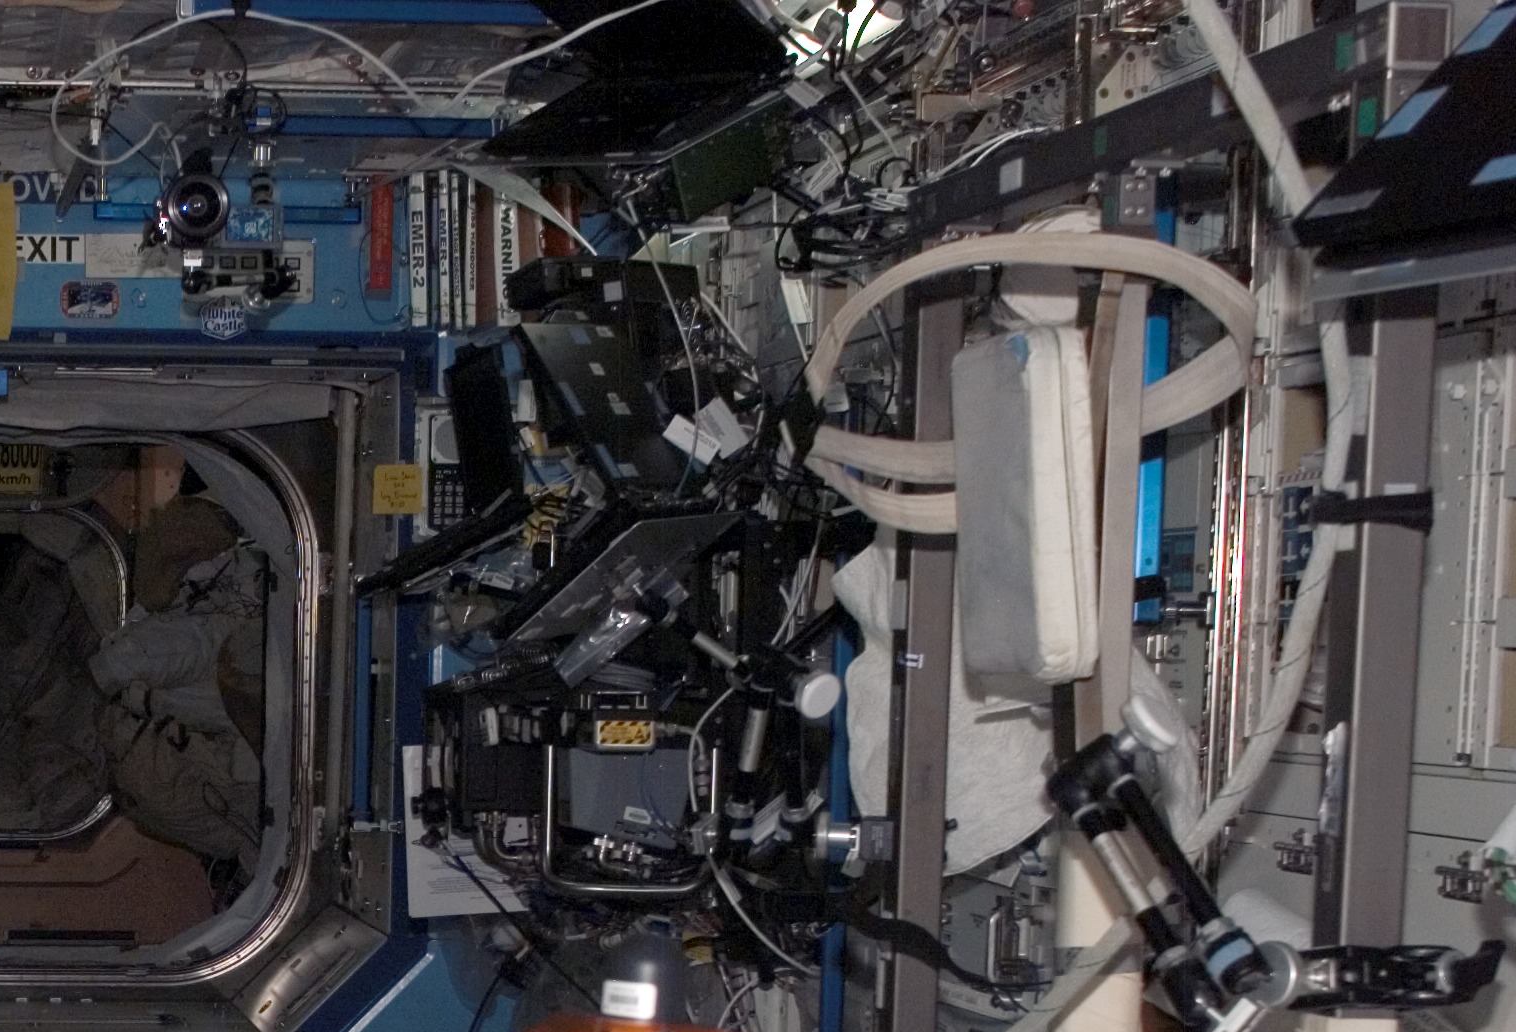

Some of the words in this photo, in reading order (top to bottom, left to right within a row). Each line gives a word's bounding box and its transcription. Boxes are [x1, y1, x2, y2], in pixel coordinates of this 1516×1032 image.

[8, 174, 98, 202] OVD
[411, 210, 425, 288] EMER-2
[439, 208, 448, 277] EMER-1
[203, 319, 245, 332] Castle
[207, 307, 244, 320] White
